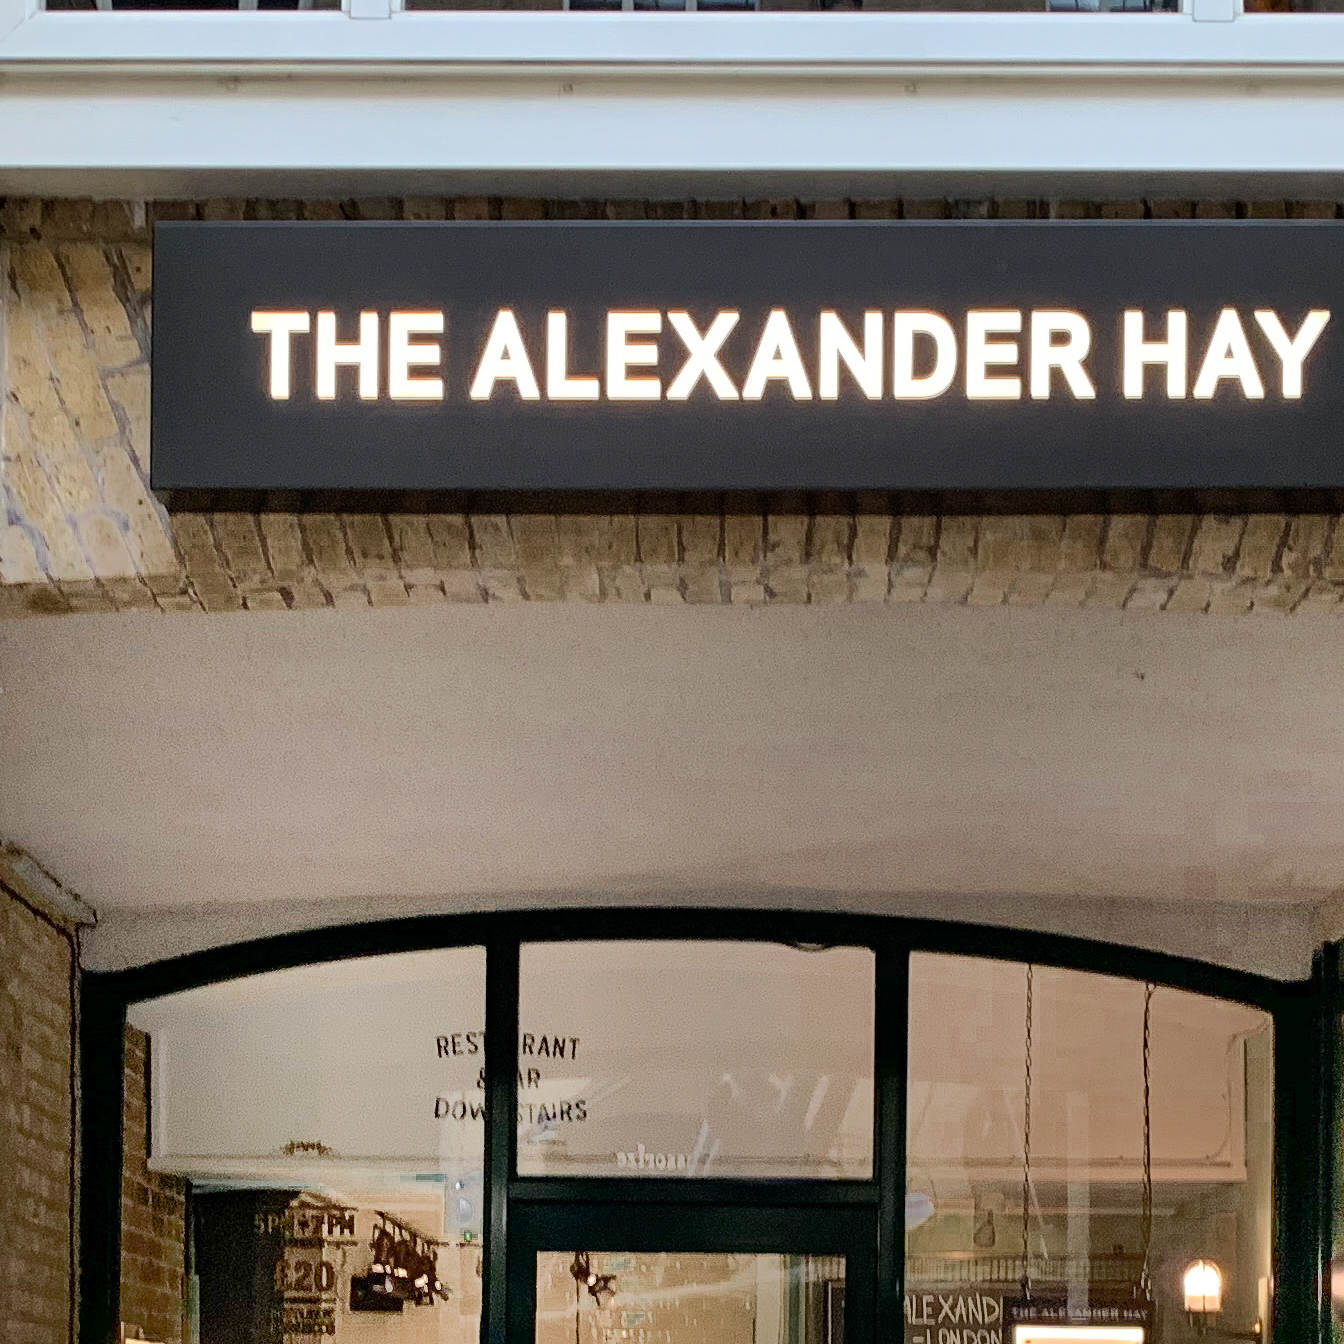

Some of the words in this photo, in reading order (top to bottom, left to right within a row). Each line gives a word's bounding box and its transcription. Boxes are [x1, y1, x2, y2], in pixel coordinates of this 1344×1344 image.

[250, 309, 445, 401] THE
[469, 308, 1097, 401] ALEXANDER
[1123, 308, 1331, 401] HAY
[434, 1031, 580, 1060] RESRANT
[1011, 1307, 1037, 1319] THE
